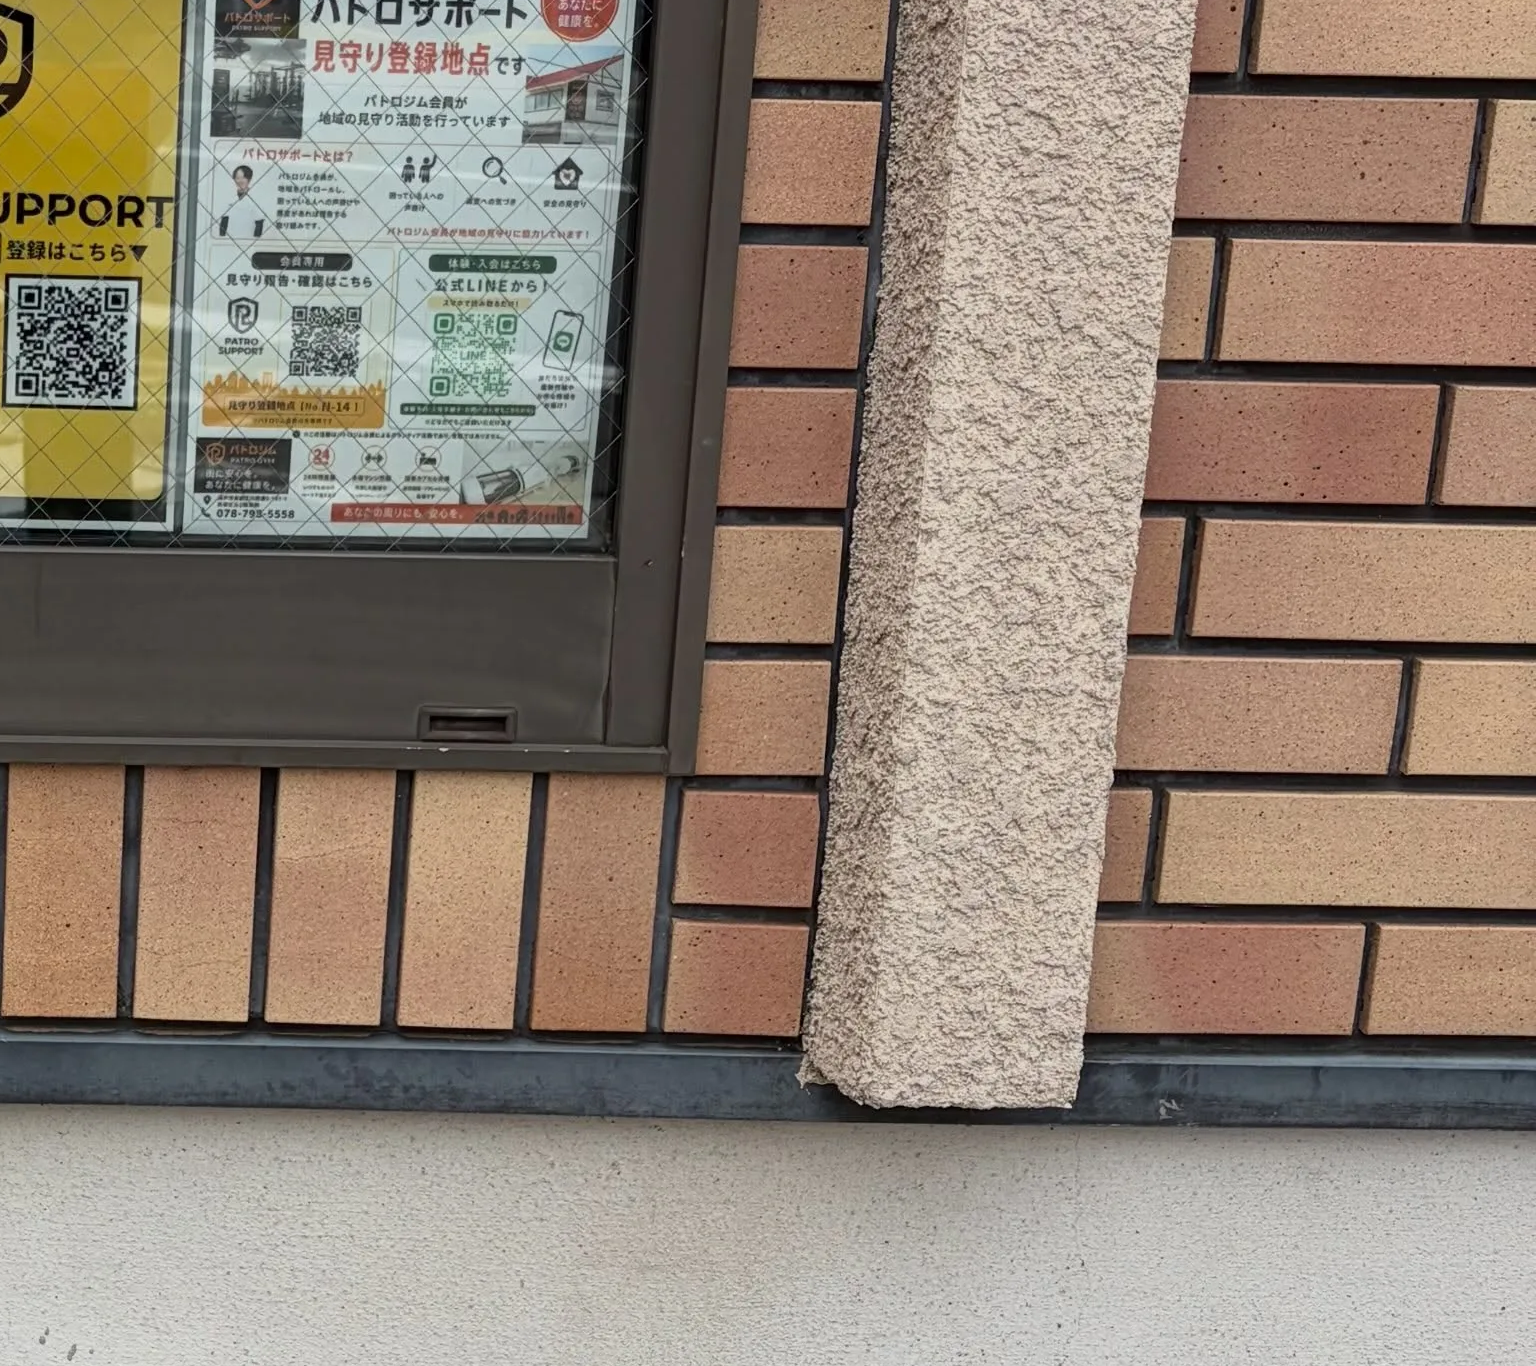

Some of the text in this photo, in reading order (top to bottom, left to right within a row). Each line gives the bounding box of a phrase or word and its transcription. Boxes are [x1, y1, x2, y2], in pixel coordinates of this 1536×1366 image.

[224, 12, 291, 25] パトロサポート
[557, 13, 600, 30] 健康を。
[364, 95, 468, 110] パトロジム会員が
[319, 113, 511, 129] 地域の見守り活動を行っています
[5, 239, 128, 263] 登録はこちら
[279, 255, 325, 268] 会員専用
[448, 258, 542, 271] 体験・入会はこちら
[225, 273, 373, 288] 見守り報告・確認はこちら
[224, 337, 259, 346] PATRO
[218, 346, 264, 356] SUPPORT
[460, 350, 487, 361] LINE
